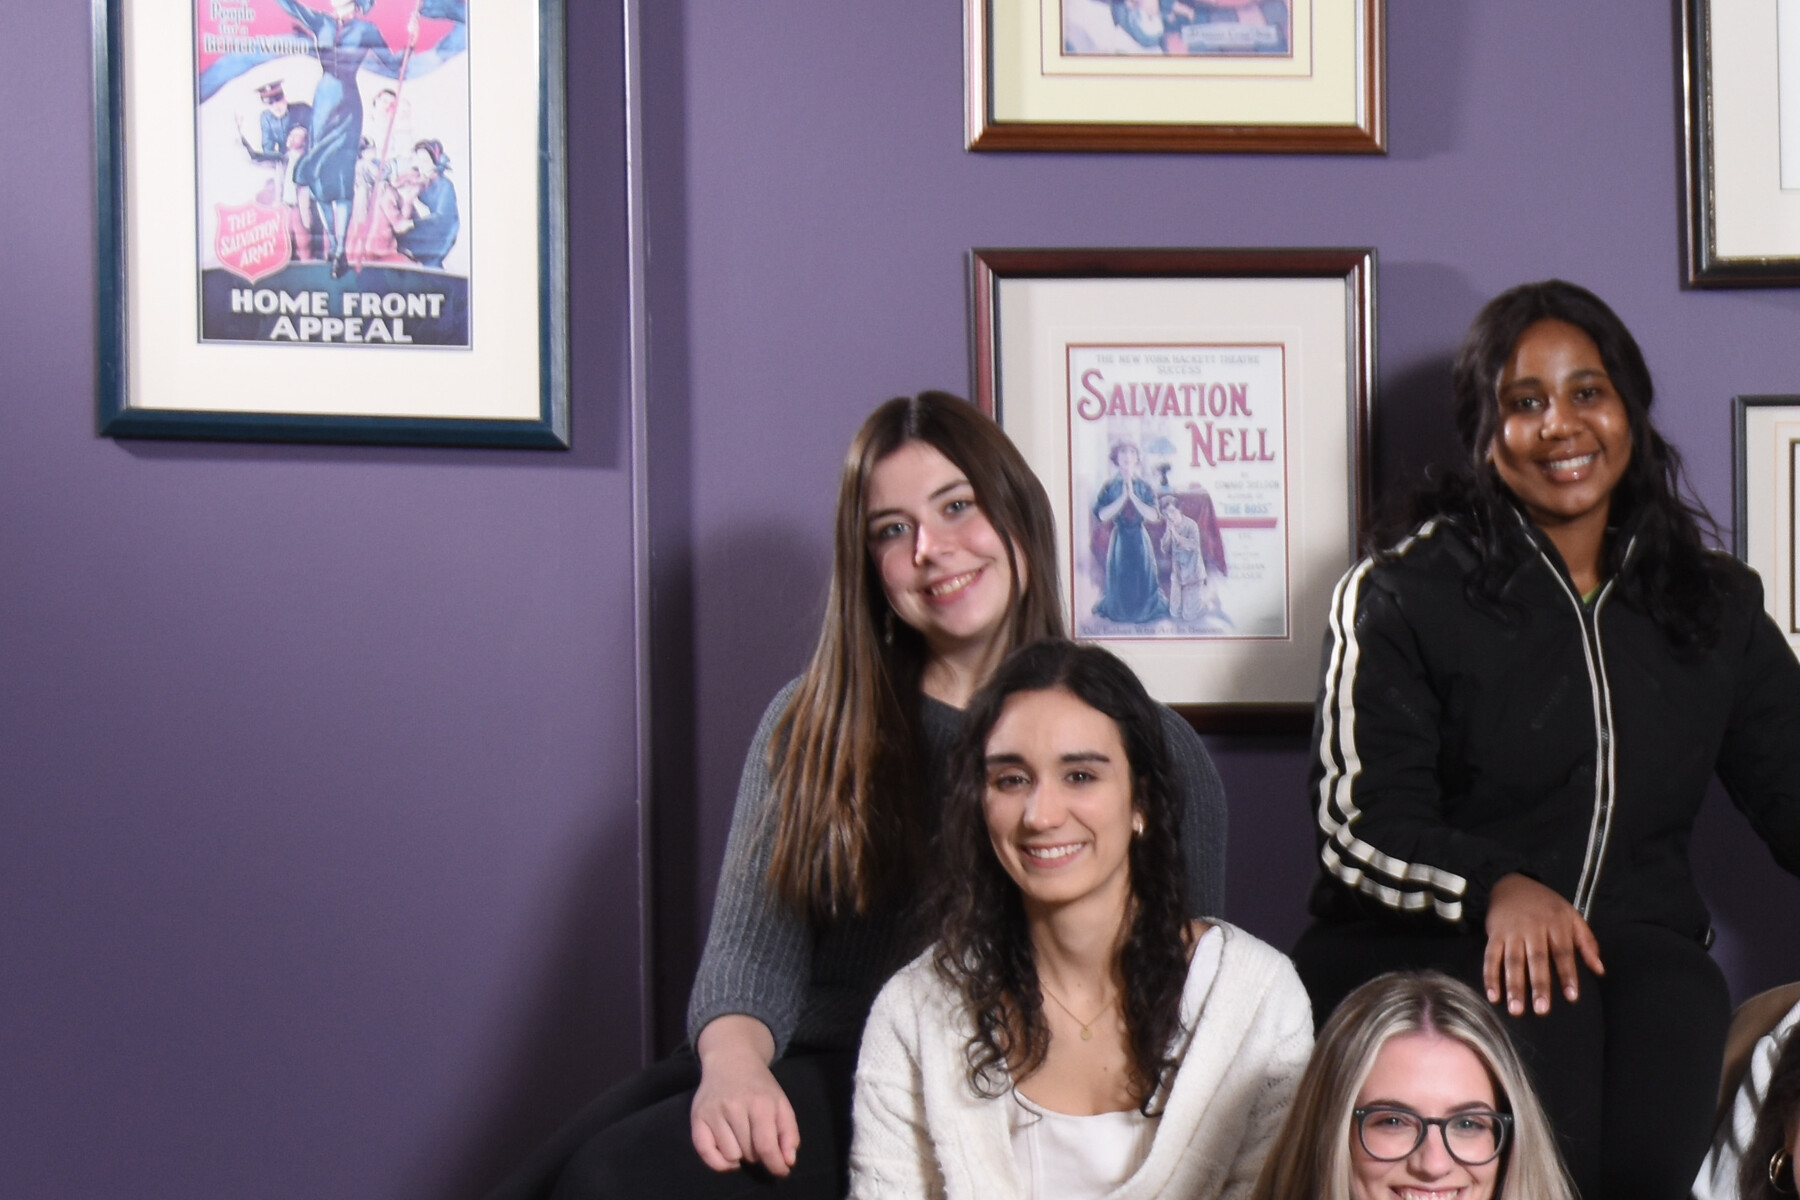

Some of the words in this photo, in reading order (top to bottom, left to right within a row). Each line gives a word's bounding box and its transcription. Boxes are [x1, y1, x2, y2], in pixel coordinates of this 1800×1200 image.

[220, 211, 281, 256] SALVATION
[228, 209, 258, 232] THE
[239, 238, 277, 268] ARMY
[231, 289, 330, 316] HOME
[343, 292, 445, 319] FRONT
[269, 315, 414, 344] APPEAL
[1119, 355, 1141, 364] NEW
[1219, 355, 1260, 364] THEATRE
[1077, 368, 1253, 421] SALVATION
[1184, 421, 1276, 468] NELL
